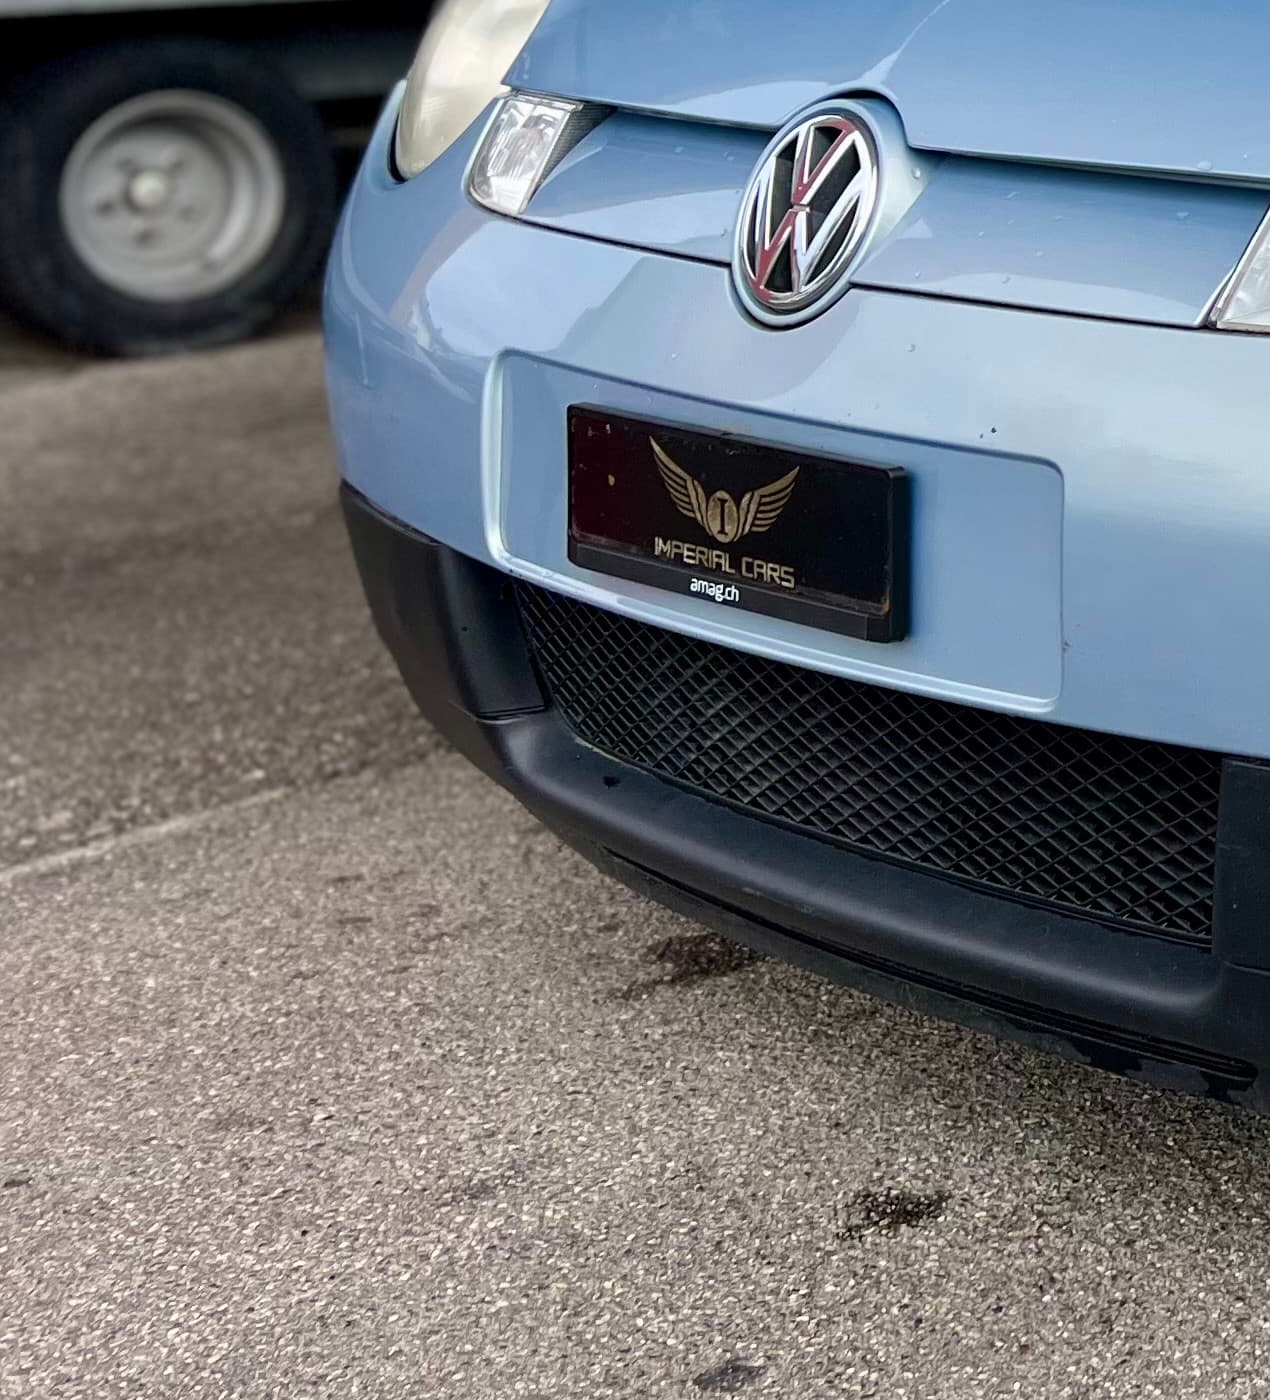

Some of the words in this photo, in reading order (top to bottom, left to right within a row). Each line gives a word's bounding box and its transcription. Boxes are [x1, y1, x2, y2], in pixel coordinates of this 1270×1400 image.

[654, 536, 736, 574] IMPERIAL
[741, 556, 796, 589] CARS
[689, 577, 740, 602] amag.ch
